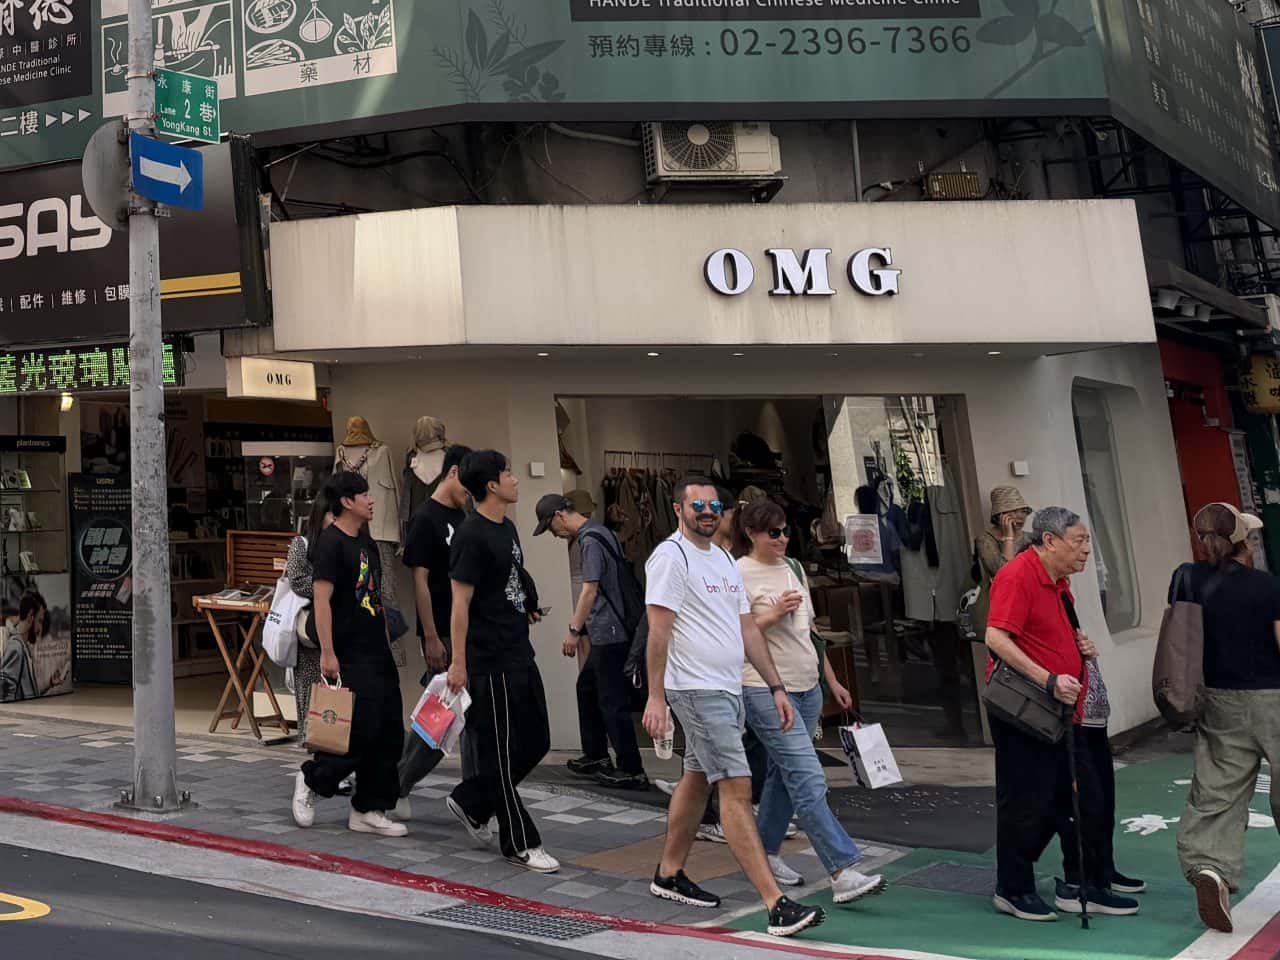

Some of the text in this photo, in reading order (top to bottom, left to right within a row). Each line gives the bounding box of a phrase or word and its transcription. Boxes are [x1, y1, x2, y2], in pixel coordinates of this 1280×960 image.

[721, 25, 971, 57] 02-2396-7366
[13, 70, 48, 83] Medicine
[49, 64, 72, 78] Clinic
[19, 54, 61, 71] Traditional
[157, 74, 215, 99] 永康街
[160, 98, 213, 123] Lane 2 巷
[161, 117, 200, 137] YongKang
[704, 247, 902, 296] OMG
[19, 293, 45, 310] 配件
[60, 288, 87, 306] 維修
[266, 371, 293, 386] OMG
